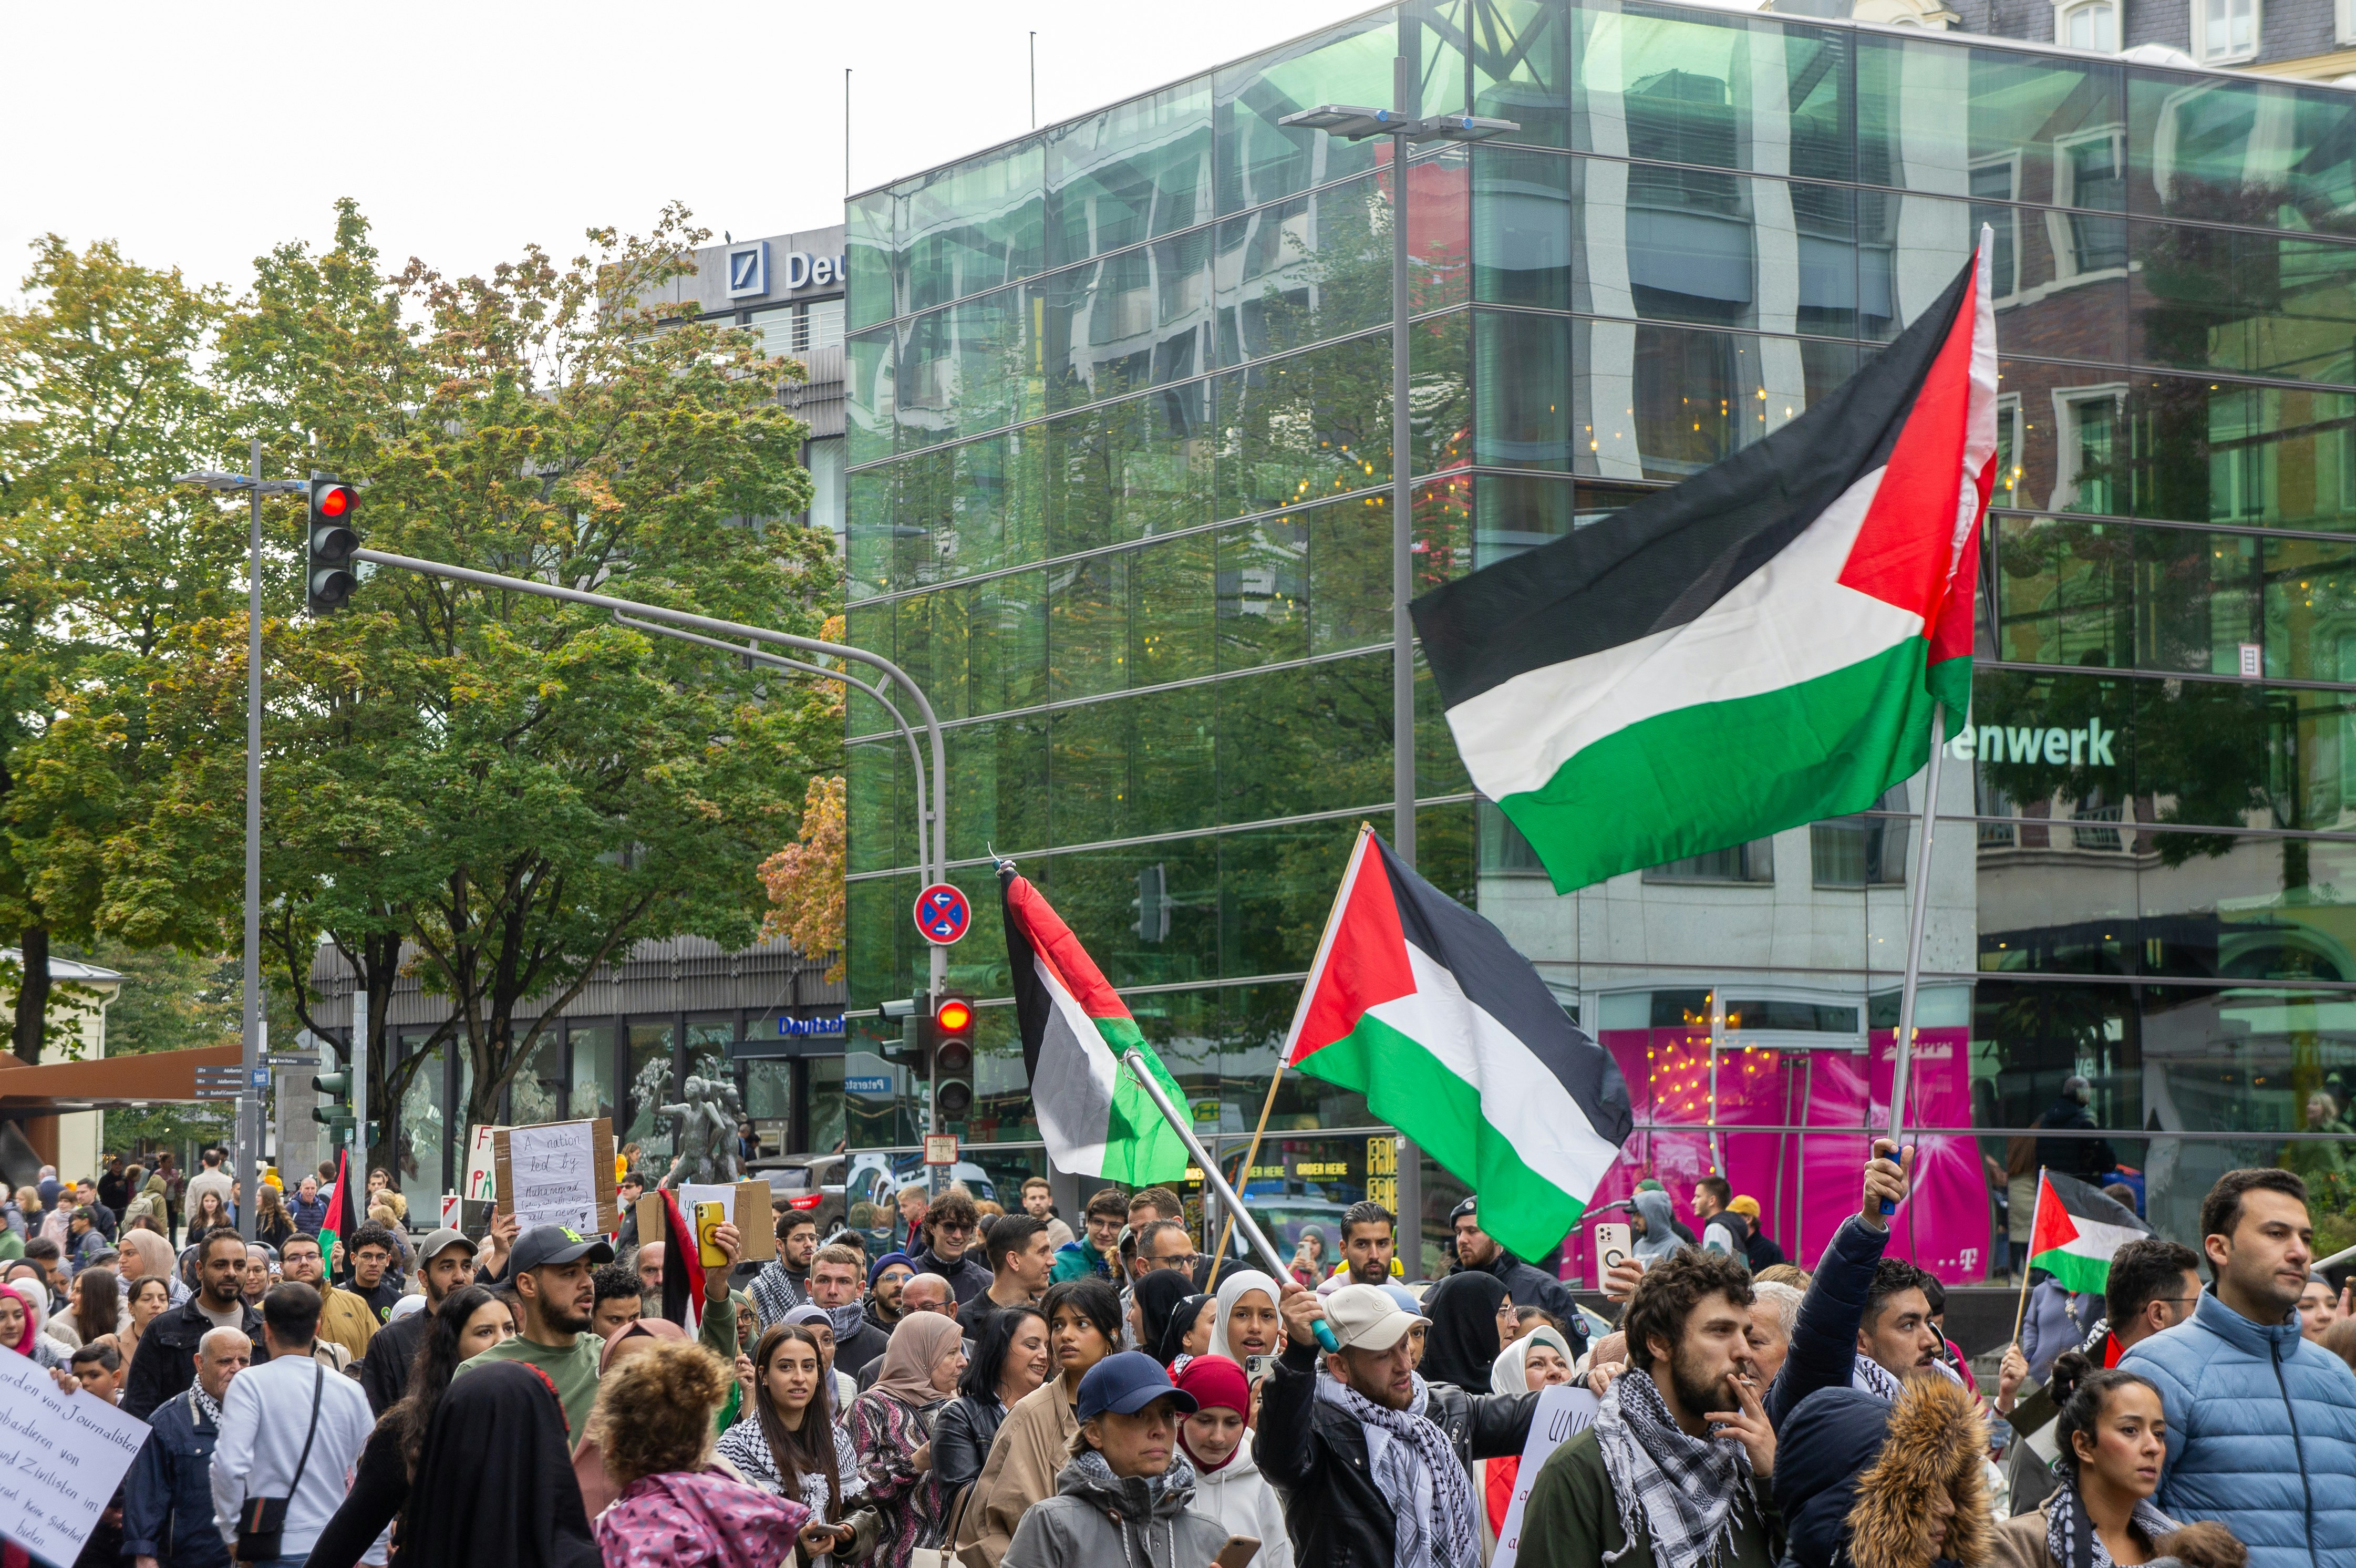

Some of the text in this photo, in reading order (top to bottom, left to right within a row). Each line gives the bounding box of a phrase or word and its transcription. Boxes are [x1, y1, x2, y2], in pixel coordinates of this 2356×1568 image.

[1942, 716, 2115, 766] enwerk
[524, 1133, 581, 1151] A nation
[531, 1153, 579, 1174] led by
[1296, 1162, 1347, 1175] ORDER HERE
[471, 1170, 497, 1200] PA
[525, 1181, 579, 1198] Muhammad
[555, 1206, 583, 1217] never
[42, 1393, 61, 1412] von
[62, 1404, 138, 1454] Journalisten
[59, 1448, 79, 1467] von
[0, 1484, 20, 1501] rael
[19, 1457, 78, 1499] Zivilisten
[84, 1497, 99, 1513] im
